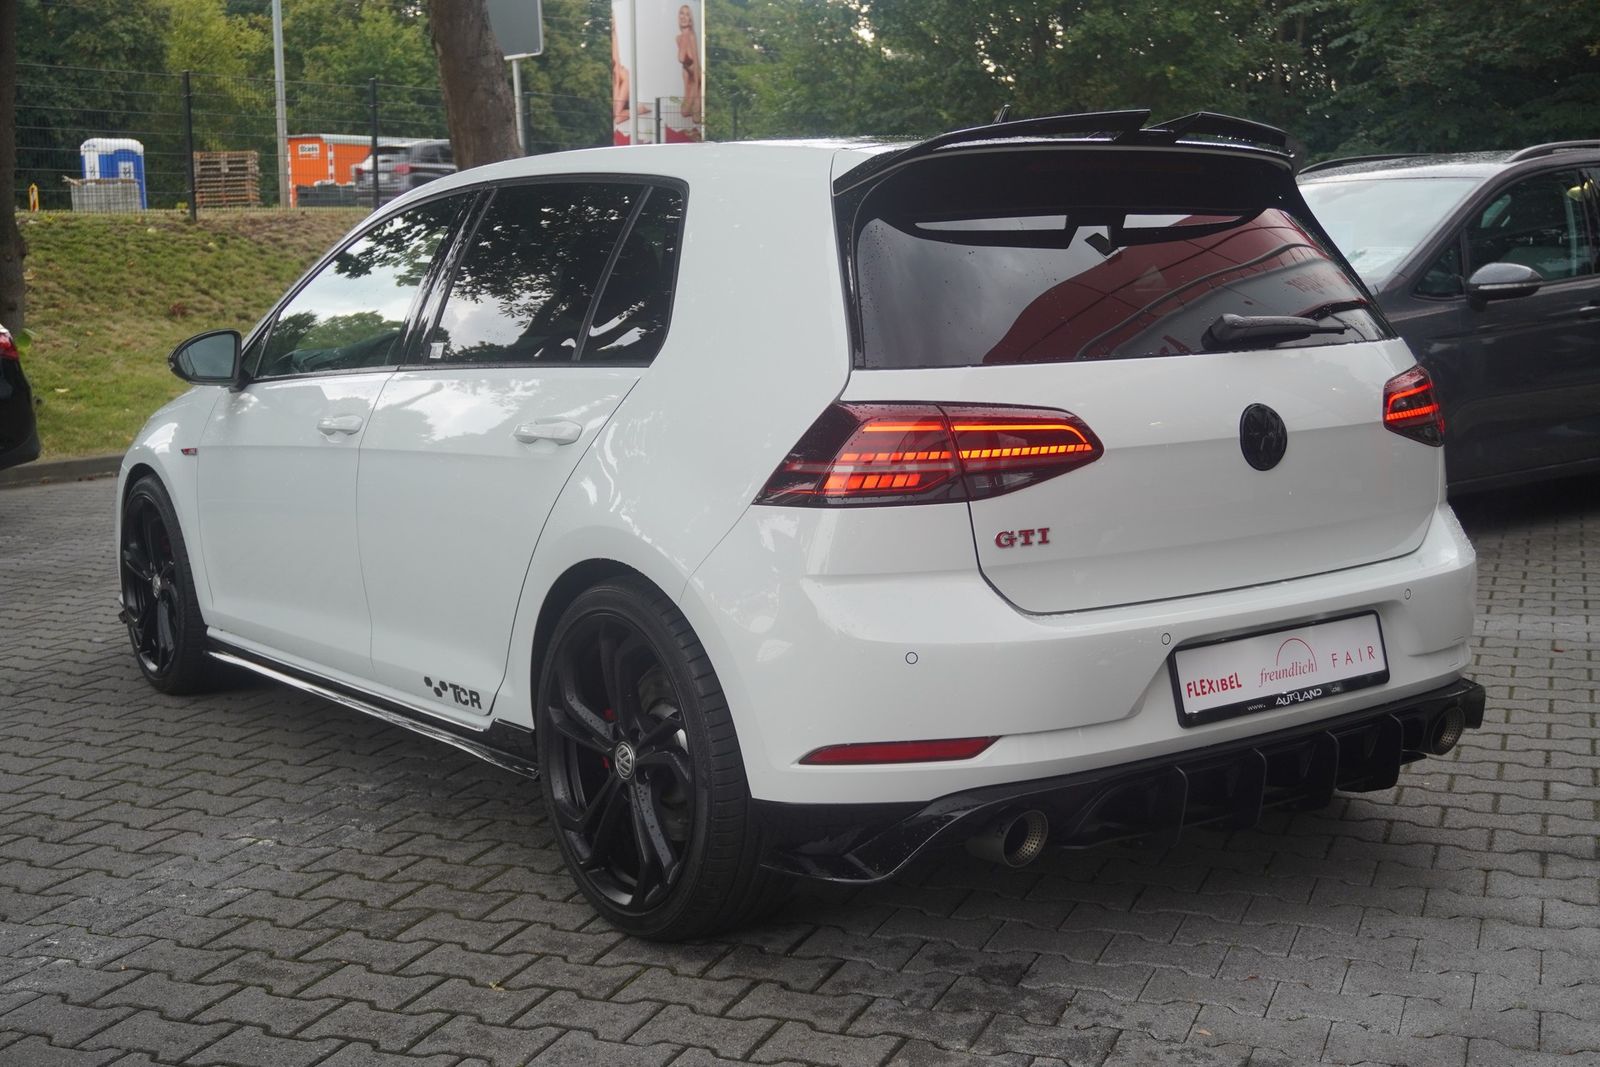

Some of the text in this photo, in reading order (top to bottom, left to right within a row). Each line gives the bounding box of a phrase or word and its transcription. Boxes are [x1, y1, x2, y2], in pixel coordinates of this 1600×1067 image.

[995, 527, 1050, 549] GTI
[1186, 645, 1375, 698] FLEXIBEL freundlich FAIR
[448, 682, 482, 709] TCR
[1275, 688, 1322, 706] AUTOLAND
